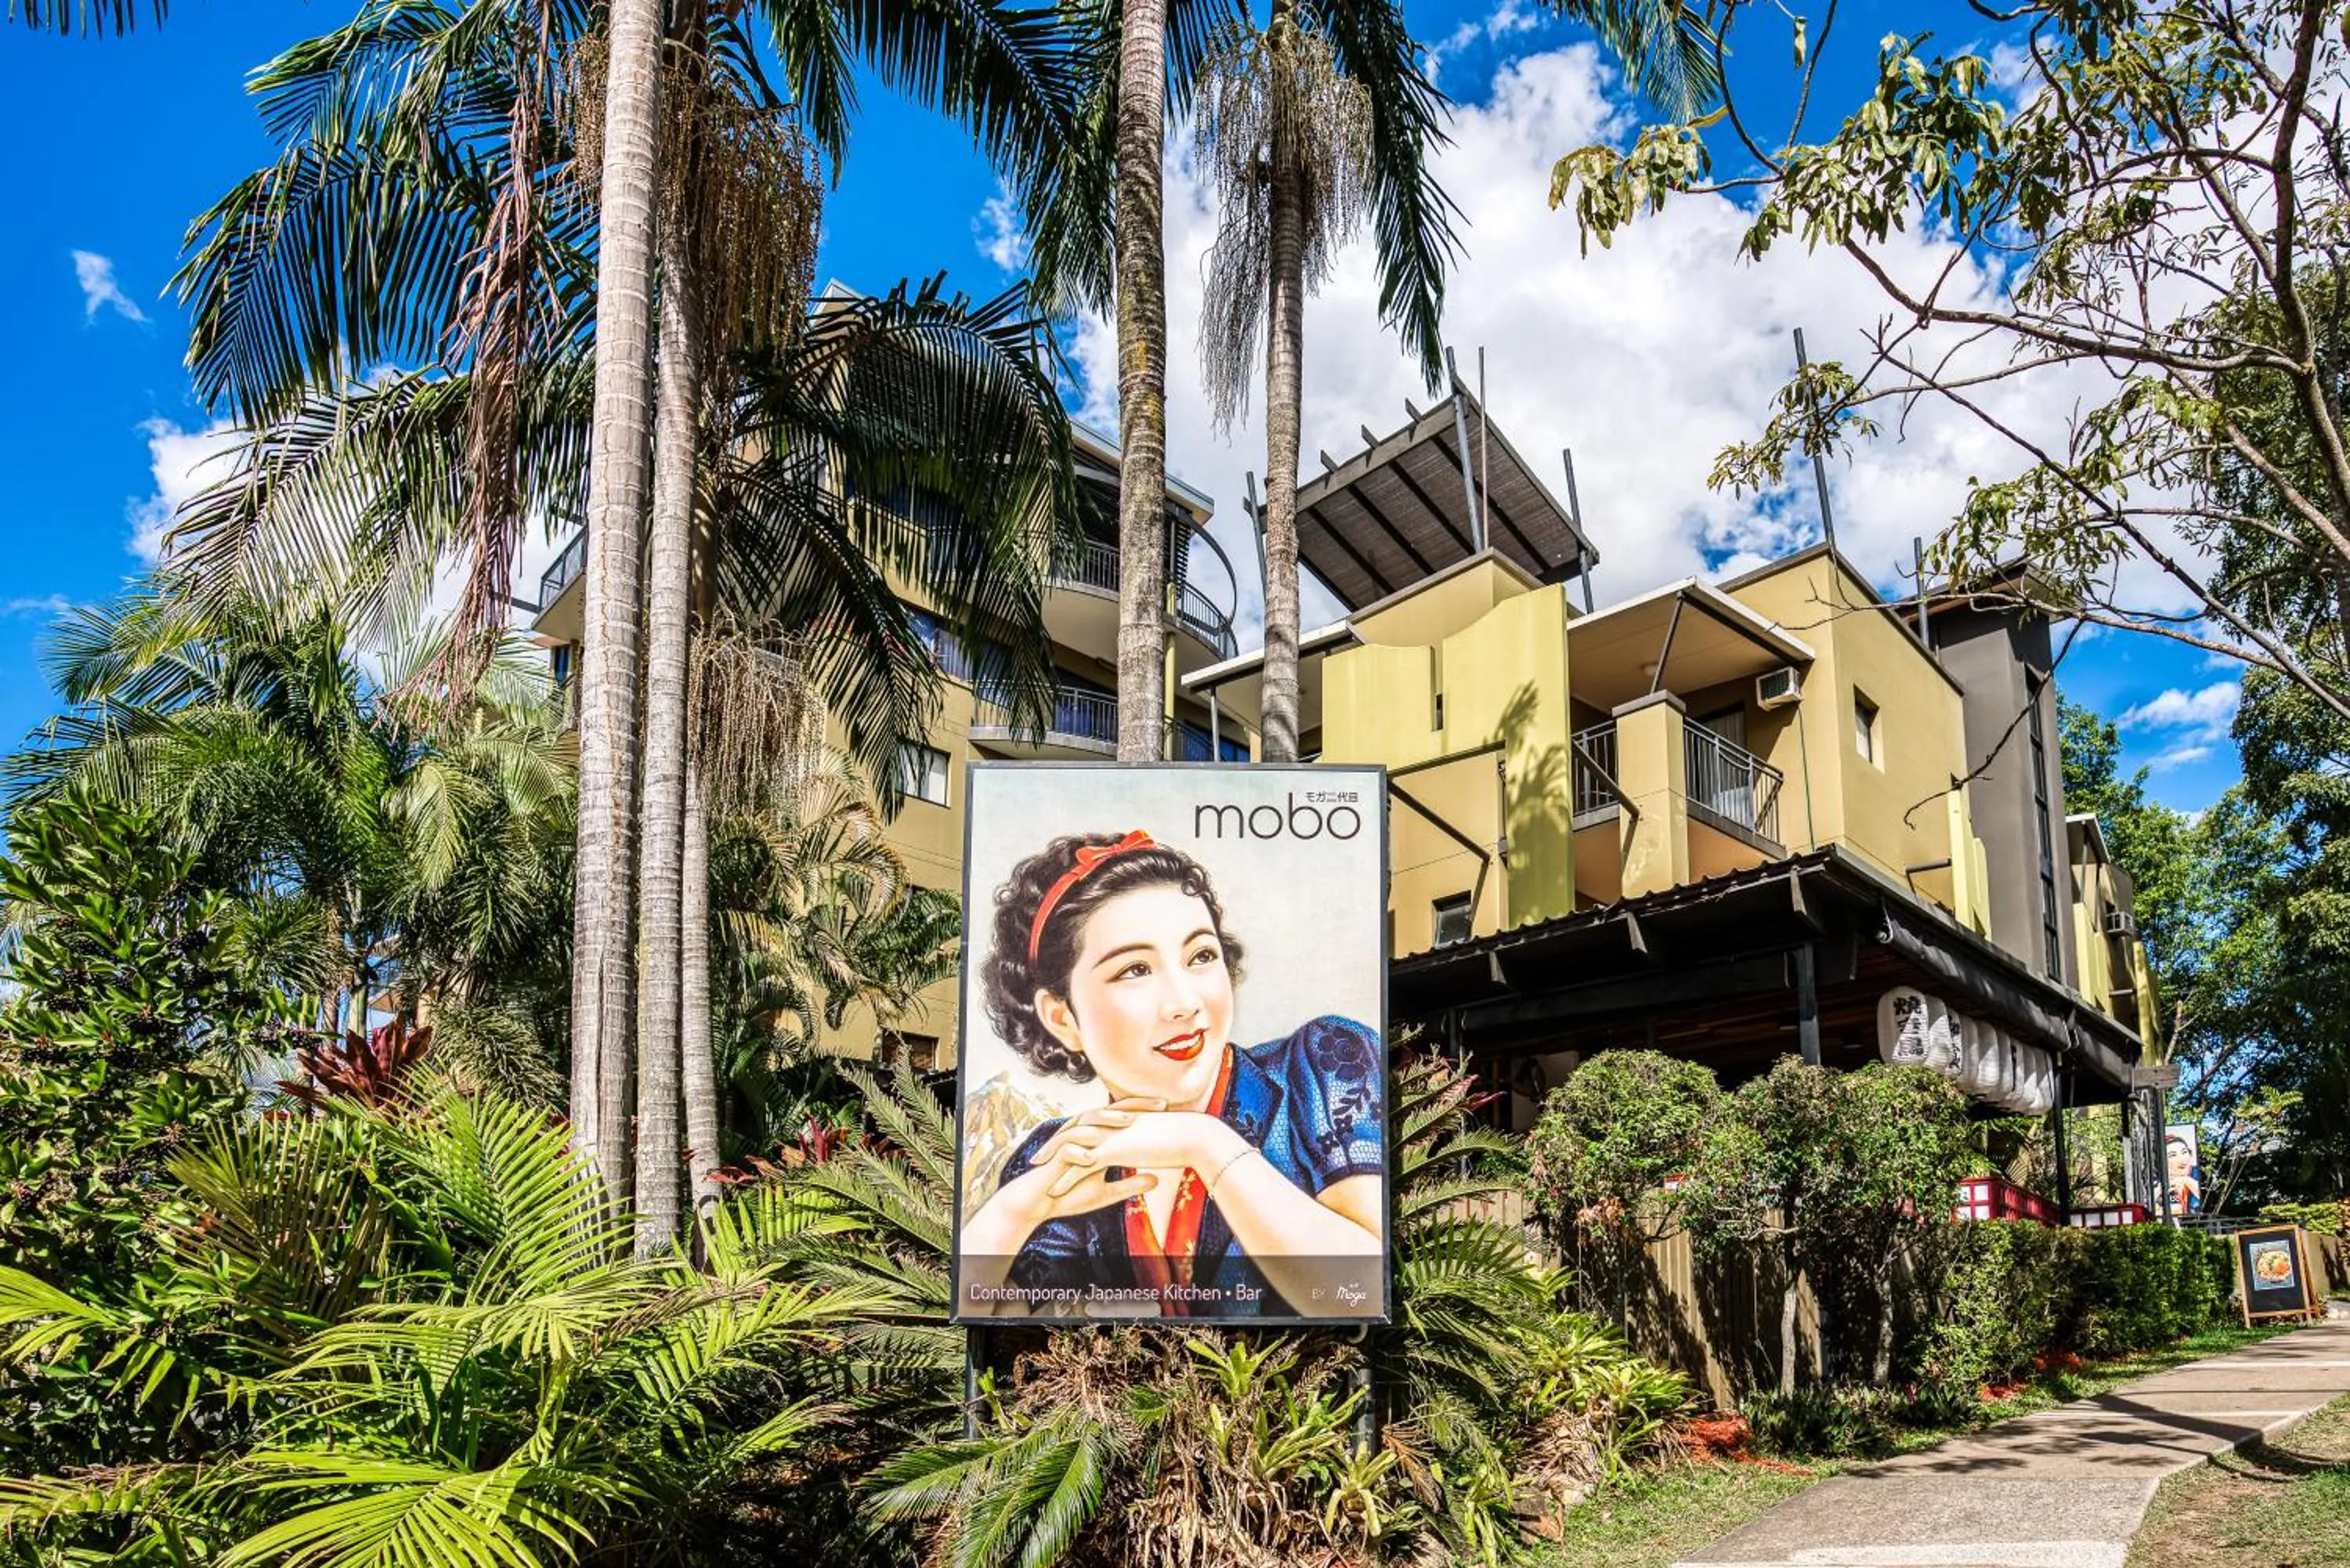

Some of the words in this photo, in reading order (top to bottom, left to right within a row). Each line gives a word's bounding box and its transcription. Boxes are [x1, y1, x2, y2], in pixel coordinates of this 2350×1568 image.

[1195, 792, 1361, 840] mobo
[971, 1284, 1082, 1305] Contemporary
[1085, 1284, 1159, 1302] Japanese
[1163, 1283, 1221, 1301] Kitchen
[1235, 1283, 1263, 1301] Bar
